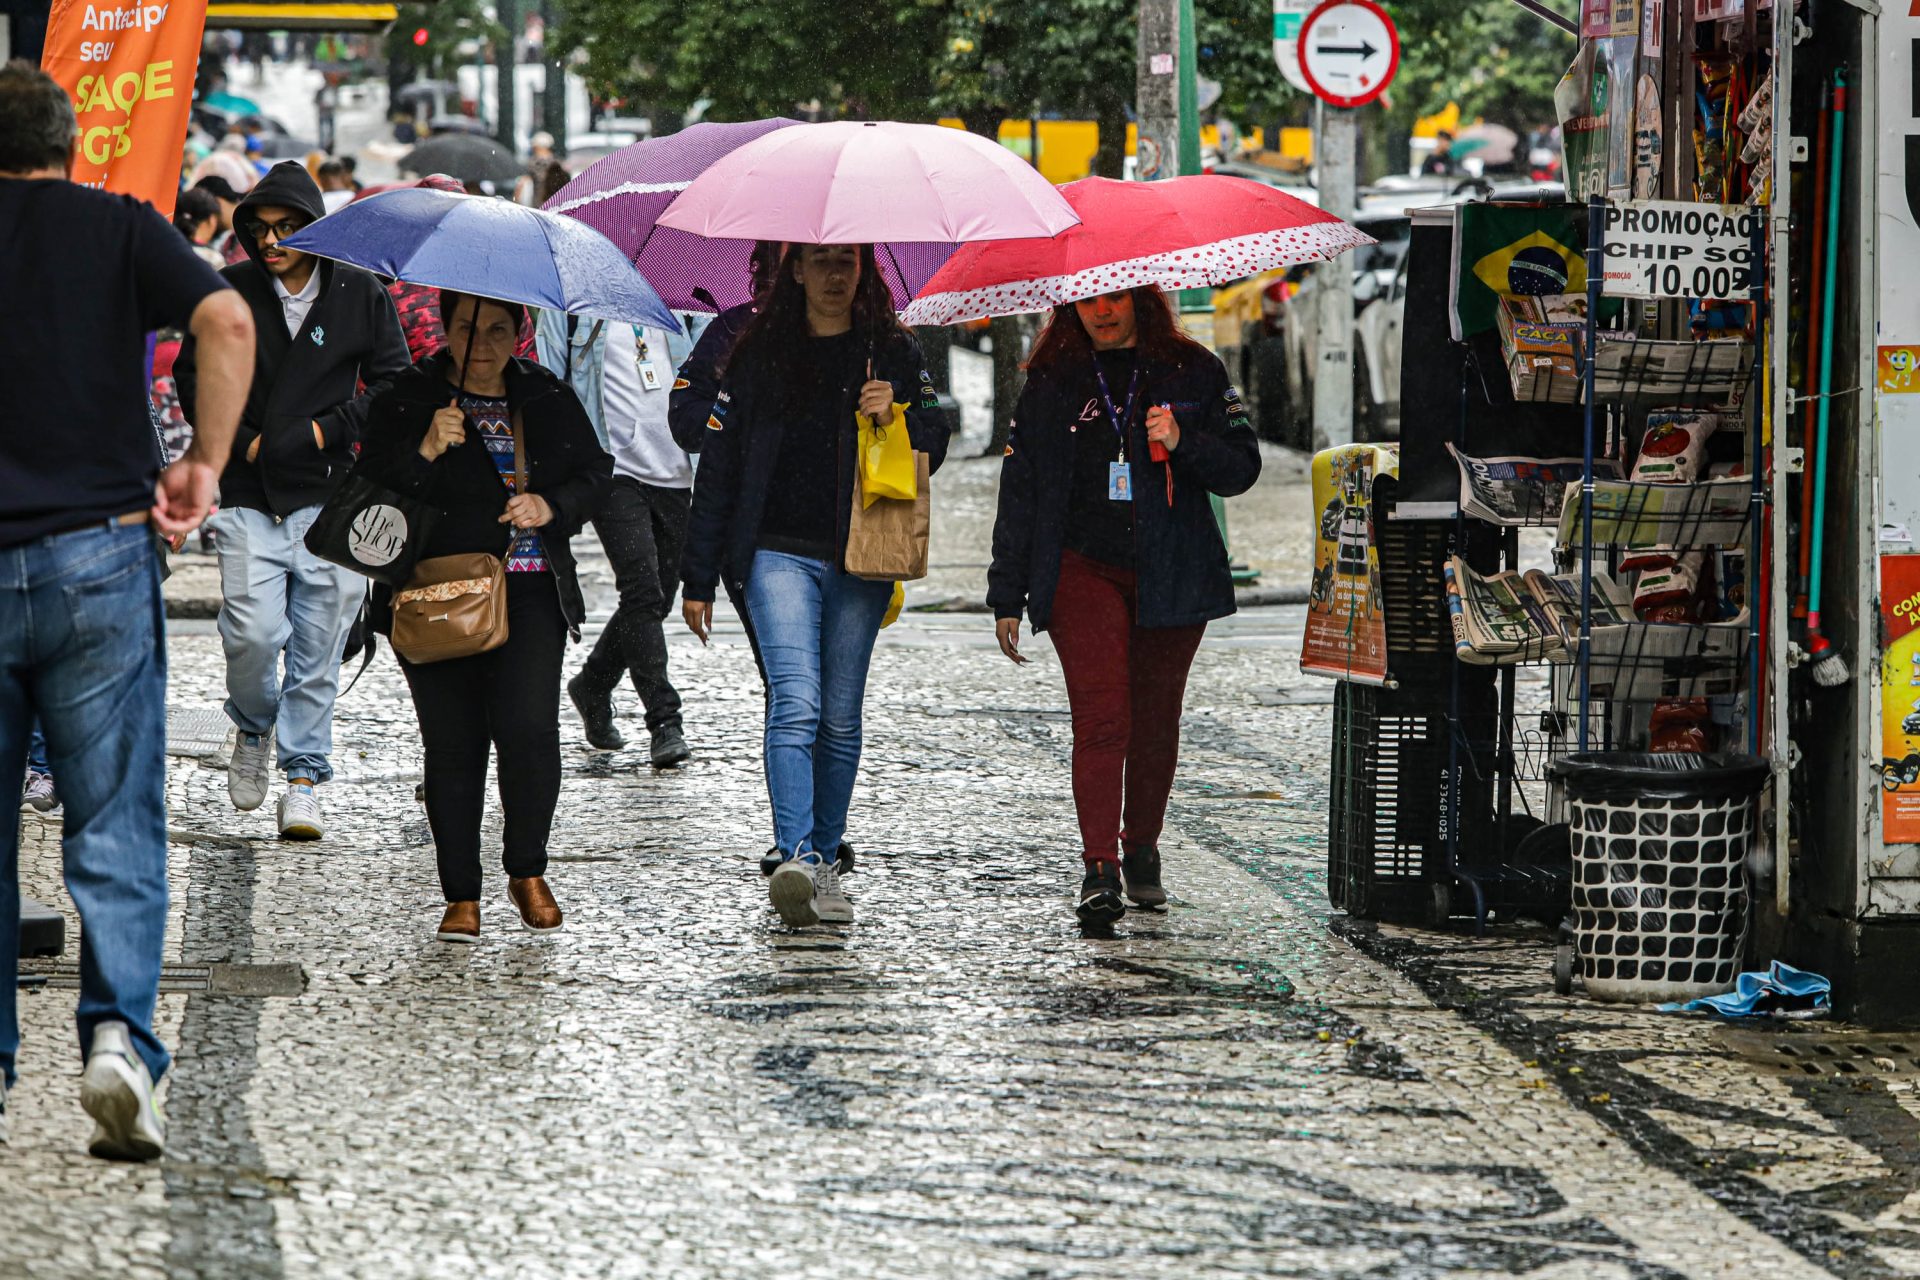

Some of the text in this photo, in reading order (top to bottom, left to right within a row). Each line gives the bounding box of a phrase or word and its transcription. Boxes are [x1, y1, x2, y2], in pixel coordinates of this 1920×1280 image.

[1604, 242, 1751, 264] CHIP SÓ
[362, 505, 394, 533] the
[350, 520, 405, 558] SHOP
[1439, 769, 1448, 840] 41 3348-1025
